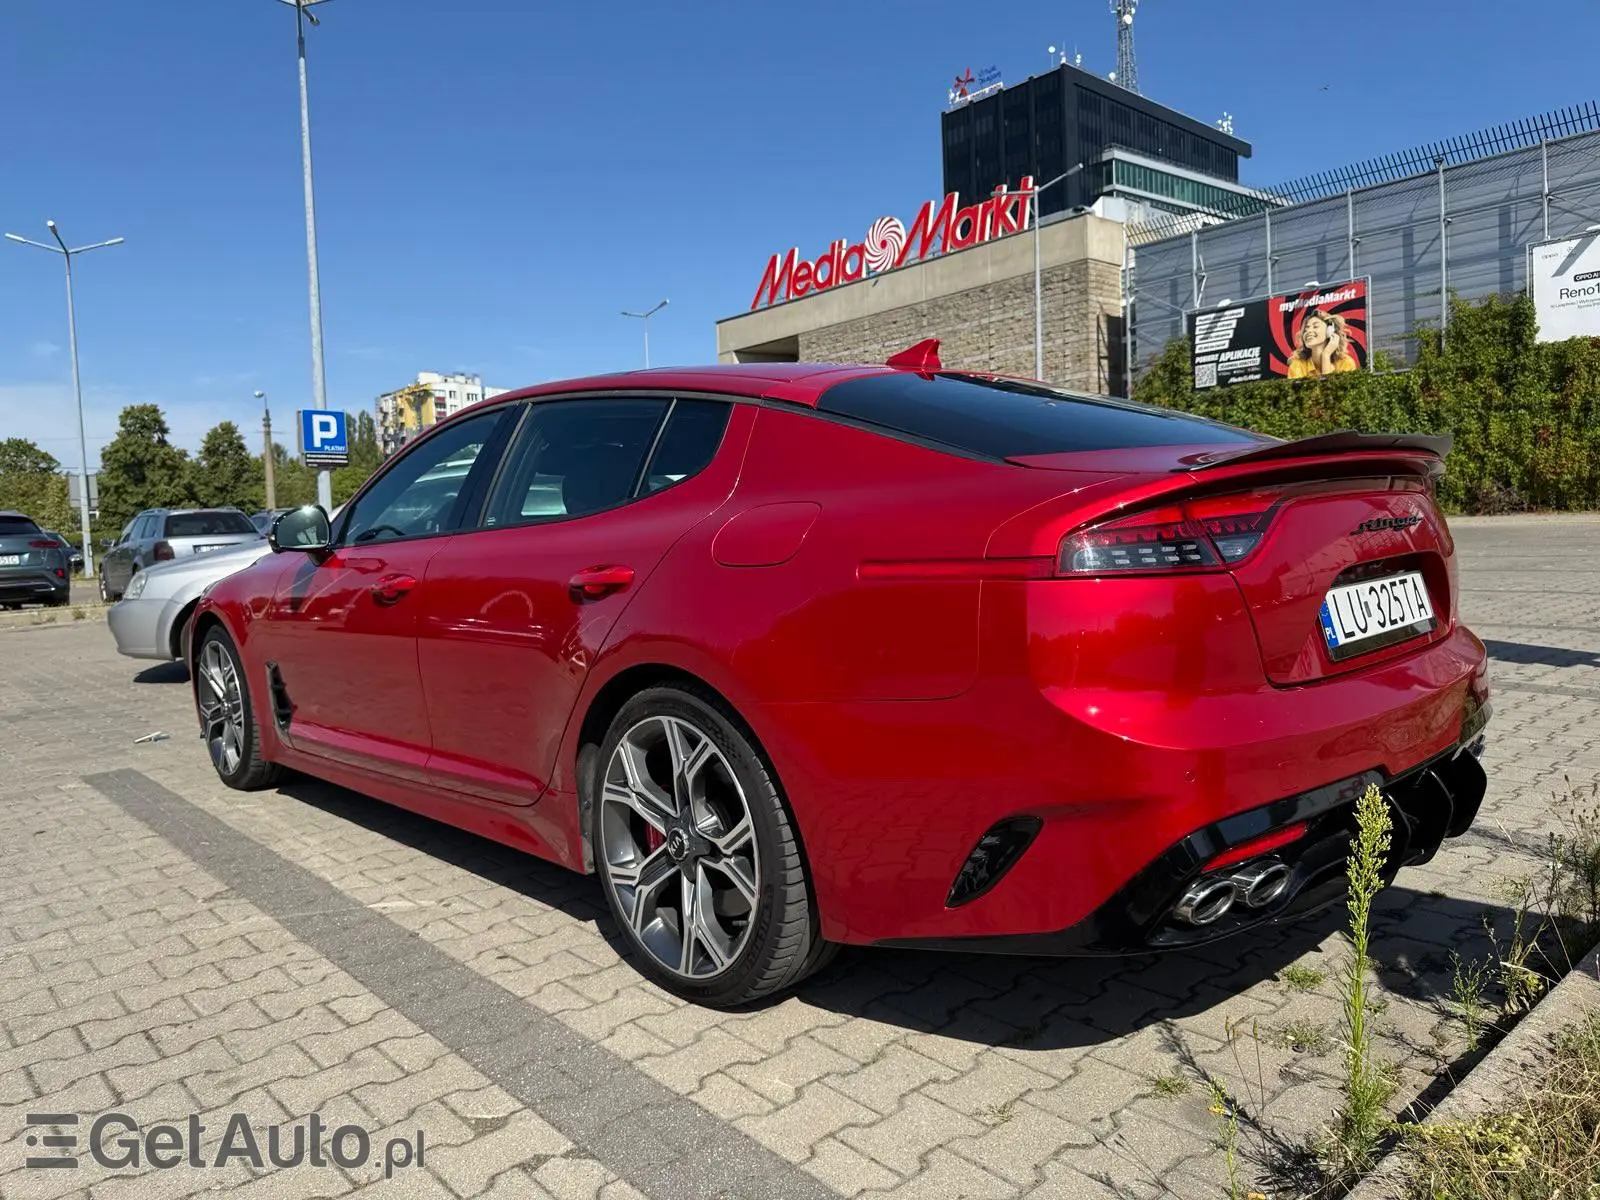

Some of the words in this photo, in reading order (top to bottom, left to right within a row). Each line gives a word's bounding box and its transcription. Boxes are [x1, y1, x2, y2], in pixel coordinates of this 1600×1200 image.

[751, 238, 867, 311] Media
[894, 175, 1034, 268] Markt
[1576, 273, 1592, 281] OPPO
[1279, 289, 1356, 312] myMediaMarkt
[312, 414, 337, 448] P
[1332, 589, 1368, 639] LU
[1370, 577, 1428, 629] 325TA
[1325, 626, 1336, 640] PL
